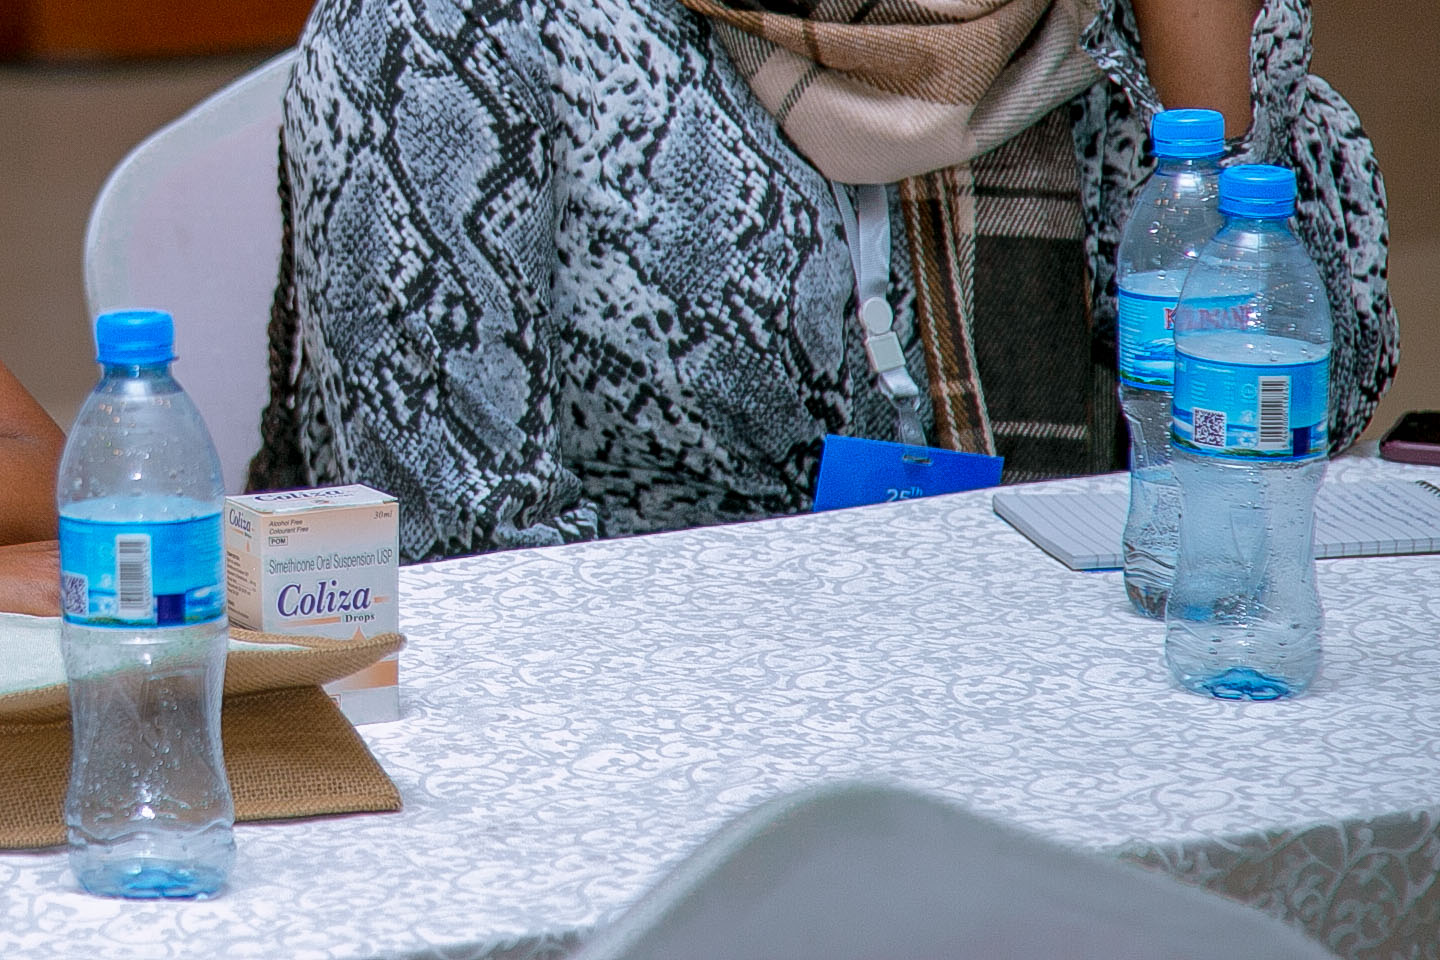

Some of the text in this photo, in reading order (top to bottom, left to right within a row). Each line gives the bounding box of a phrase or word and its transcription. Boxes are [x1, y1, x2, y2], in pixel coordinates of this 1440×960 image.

[229, 508, 252, 532] Coliza
[373, 510, 393, 520] 30ml
[269, 548, 393, 575] Simethicone Oral Suspension USP
[277, 580, 371, 617] Coliza
[345, 613, 375, 623] Drops
